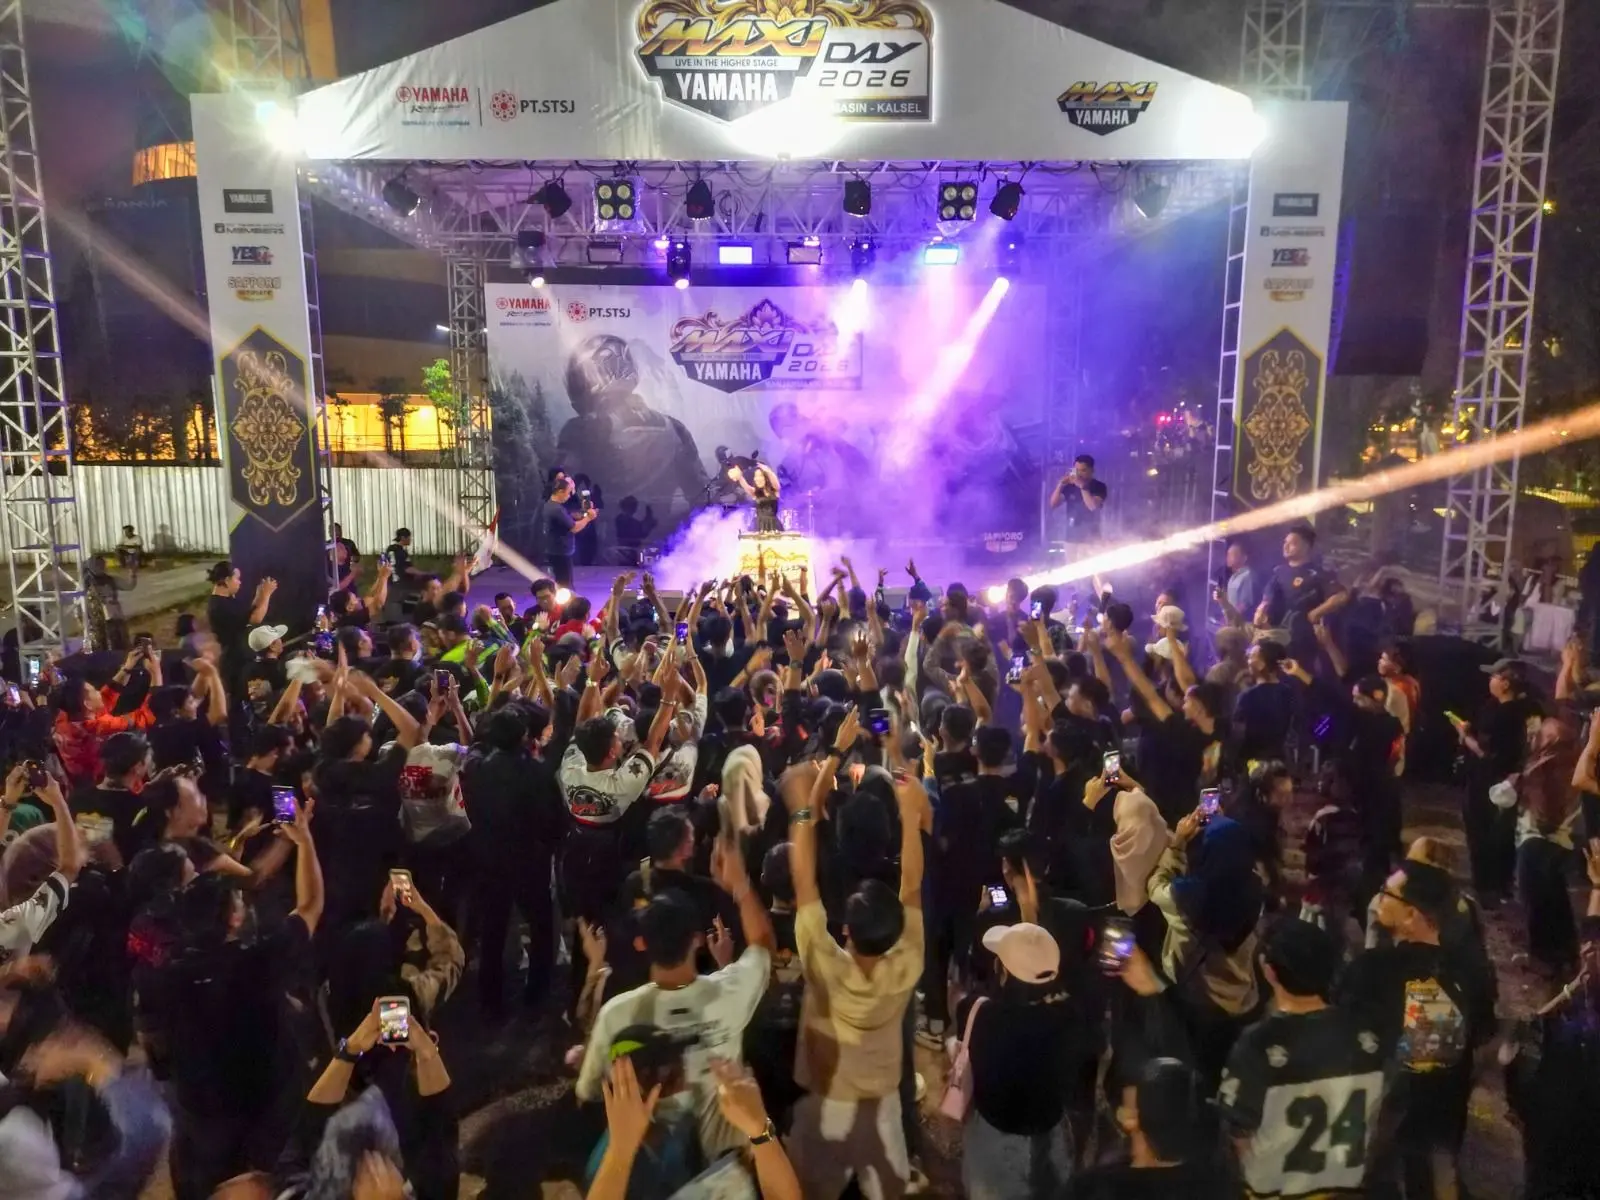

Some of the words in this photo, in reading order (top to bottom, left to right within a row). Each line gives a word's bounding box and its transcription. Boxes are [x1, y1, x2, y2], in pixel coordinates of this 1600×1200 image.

[639, 18, 829, 56] MAXI
[823, 42, 923, 64] DAY
[675, 59, 693, 67] LIVE
[694, 59, 703, 67] IN
[705, 59, 718, 67] THE
[720, 59, 751, 67] HIGHER
[753, 59, 778, 67] STAGE
[675, 72, 779, 101] YAMAHA
[818, 69, 911, 87] 2026
[412, 87, 469, 102] YAMAHA
[520, 99, 575, 114] PT.STSJ
[877, 102, 922, 113] KALSEL
[1075, 109, 1129, 125] YAMAHA
[589, 307, 631, 319] PT.STSJ
[694, 362, 763, 381] YAMAHA
[1282, 1088, 1367, 1175] 24
